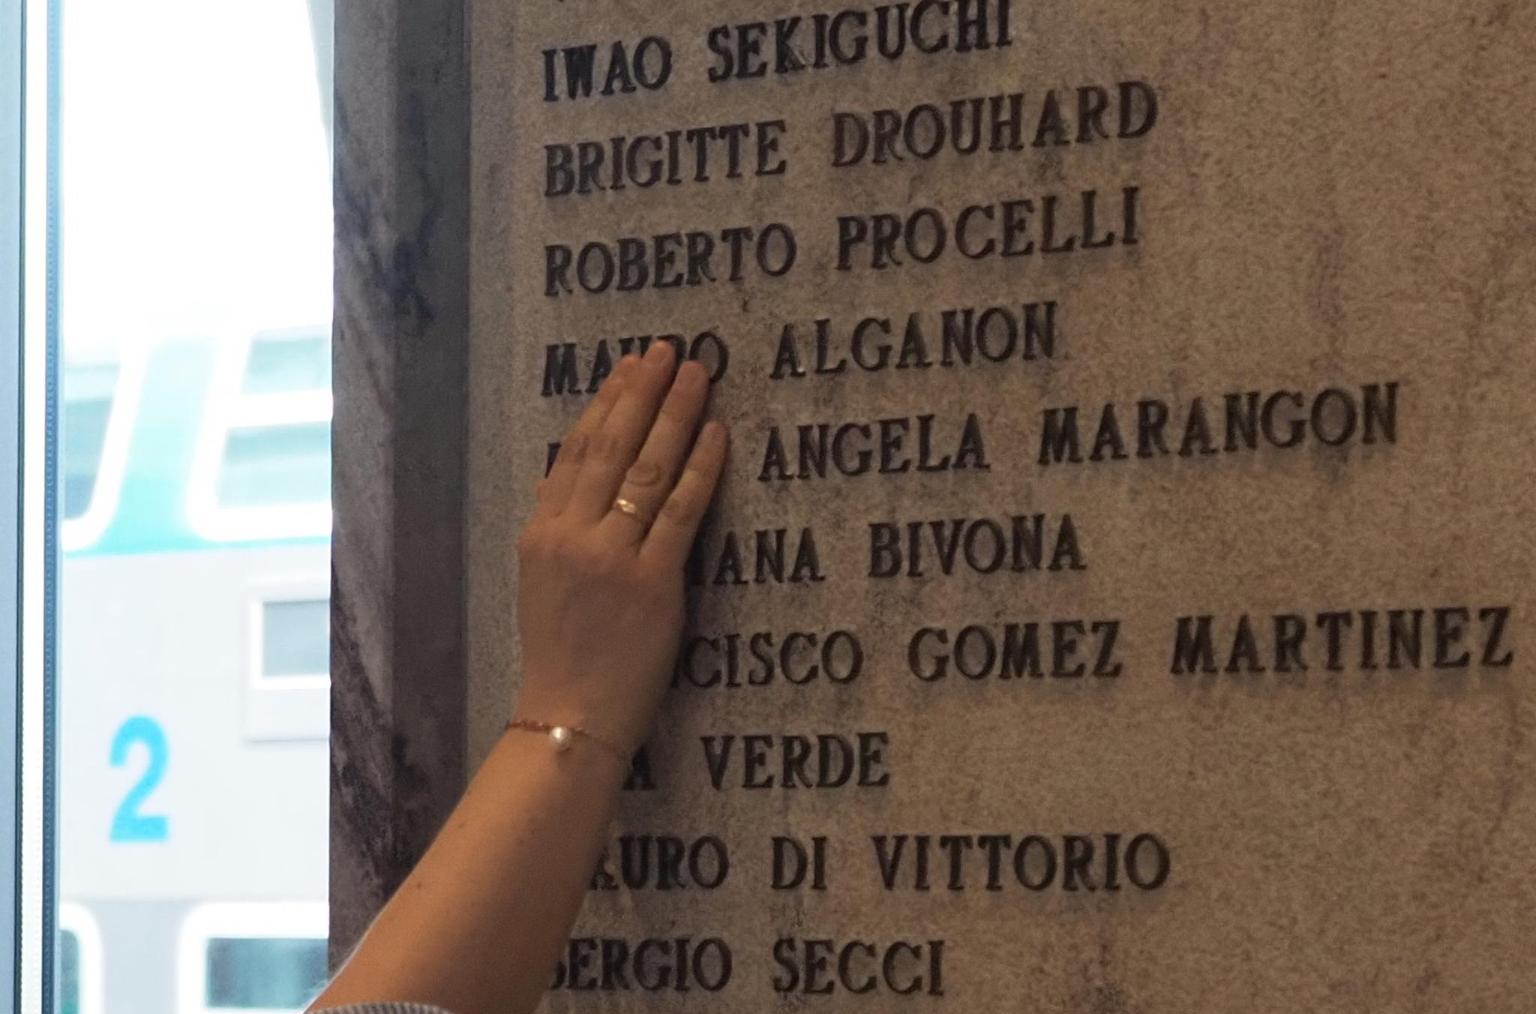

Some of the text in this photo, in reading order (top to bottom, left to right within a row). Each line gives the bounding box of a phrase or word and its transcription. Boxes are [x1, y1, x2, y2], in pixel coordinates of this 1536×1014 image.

[542, 0, 1012, 100] IWAO SEKIGUCHI
[544, 80, 1158, 197] BRIGITTE DROUHARD
[544, 186, 1140, 296] ROBERTO PROCELLI
[770, 301, 1057, 380] ALGANON
[758, 382, 1399, 482] ANGELA MARANGON
[869, 514, 1087, 578] BIVONA
[908, 620, 1123, 682] GOMEZ
[1171, 606, 1514, 675] MARTINEZ
[110, 715, 169, 841] 2
[700, 732, 890, 791] VERDE
[771, 836, 827, 892] DI
[873, 833, 1171, 893] VITTORIO
[773, 937, 946, 997] SECCI
